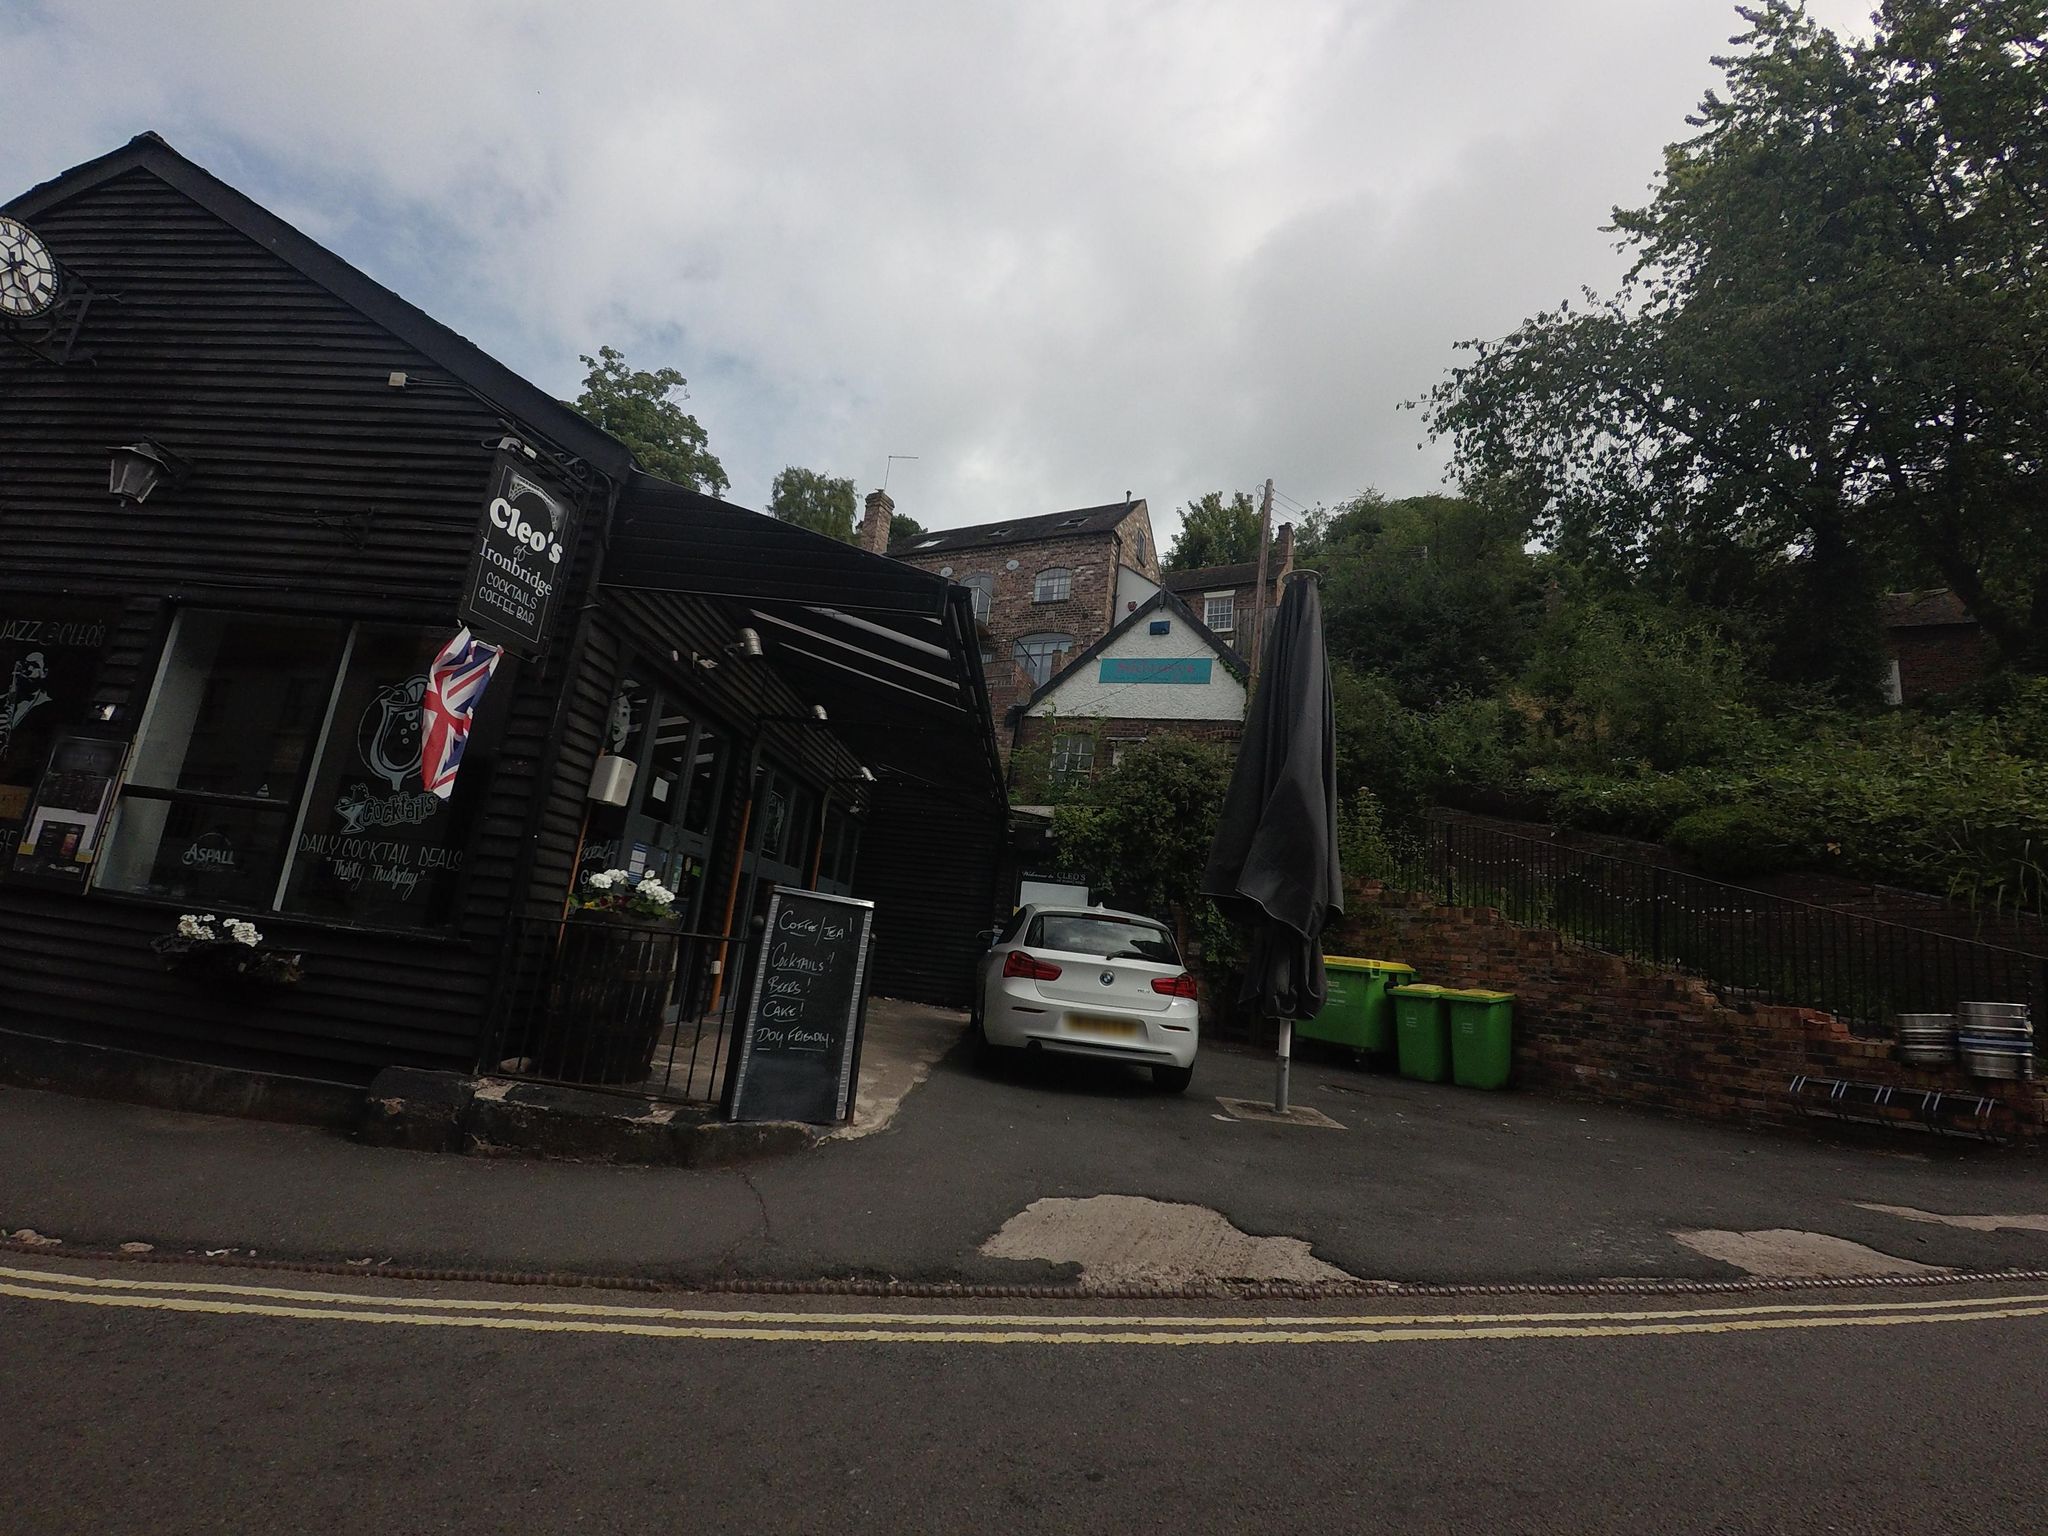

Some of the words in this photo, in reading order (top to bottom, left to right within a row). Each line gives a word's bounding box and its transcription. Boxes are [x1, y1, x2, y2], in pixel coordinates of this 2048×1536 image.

[489, 497, 563, 564] Cleo's
[479, 536, 553, 598] Ironbridge
[513, 544, 534, 562] of
[479, 586, 516, 616] COFFEE
[515, 605, 536, 627] BAR
[486, 571, 538, 610] COCKTAILS
[0, 619, 43, 642] JAZZ
[361, 791, 438, 827] Cocktails
[299, 832, 341, 856] DAILY
[341, 837, 412, 866] COCKTAIL
[418, 845, 465, 872] DEALS
